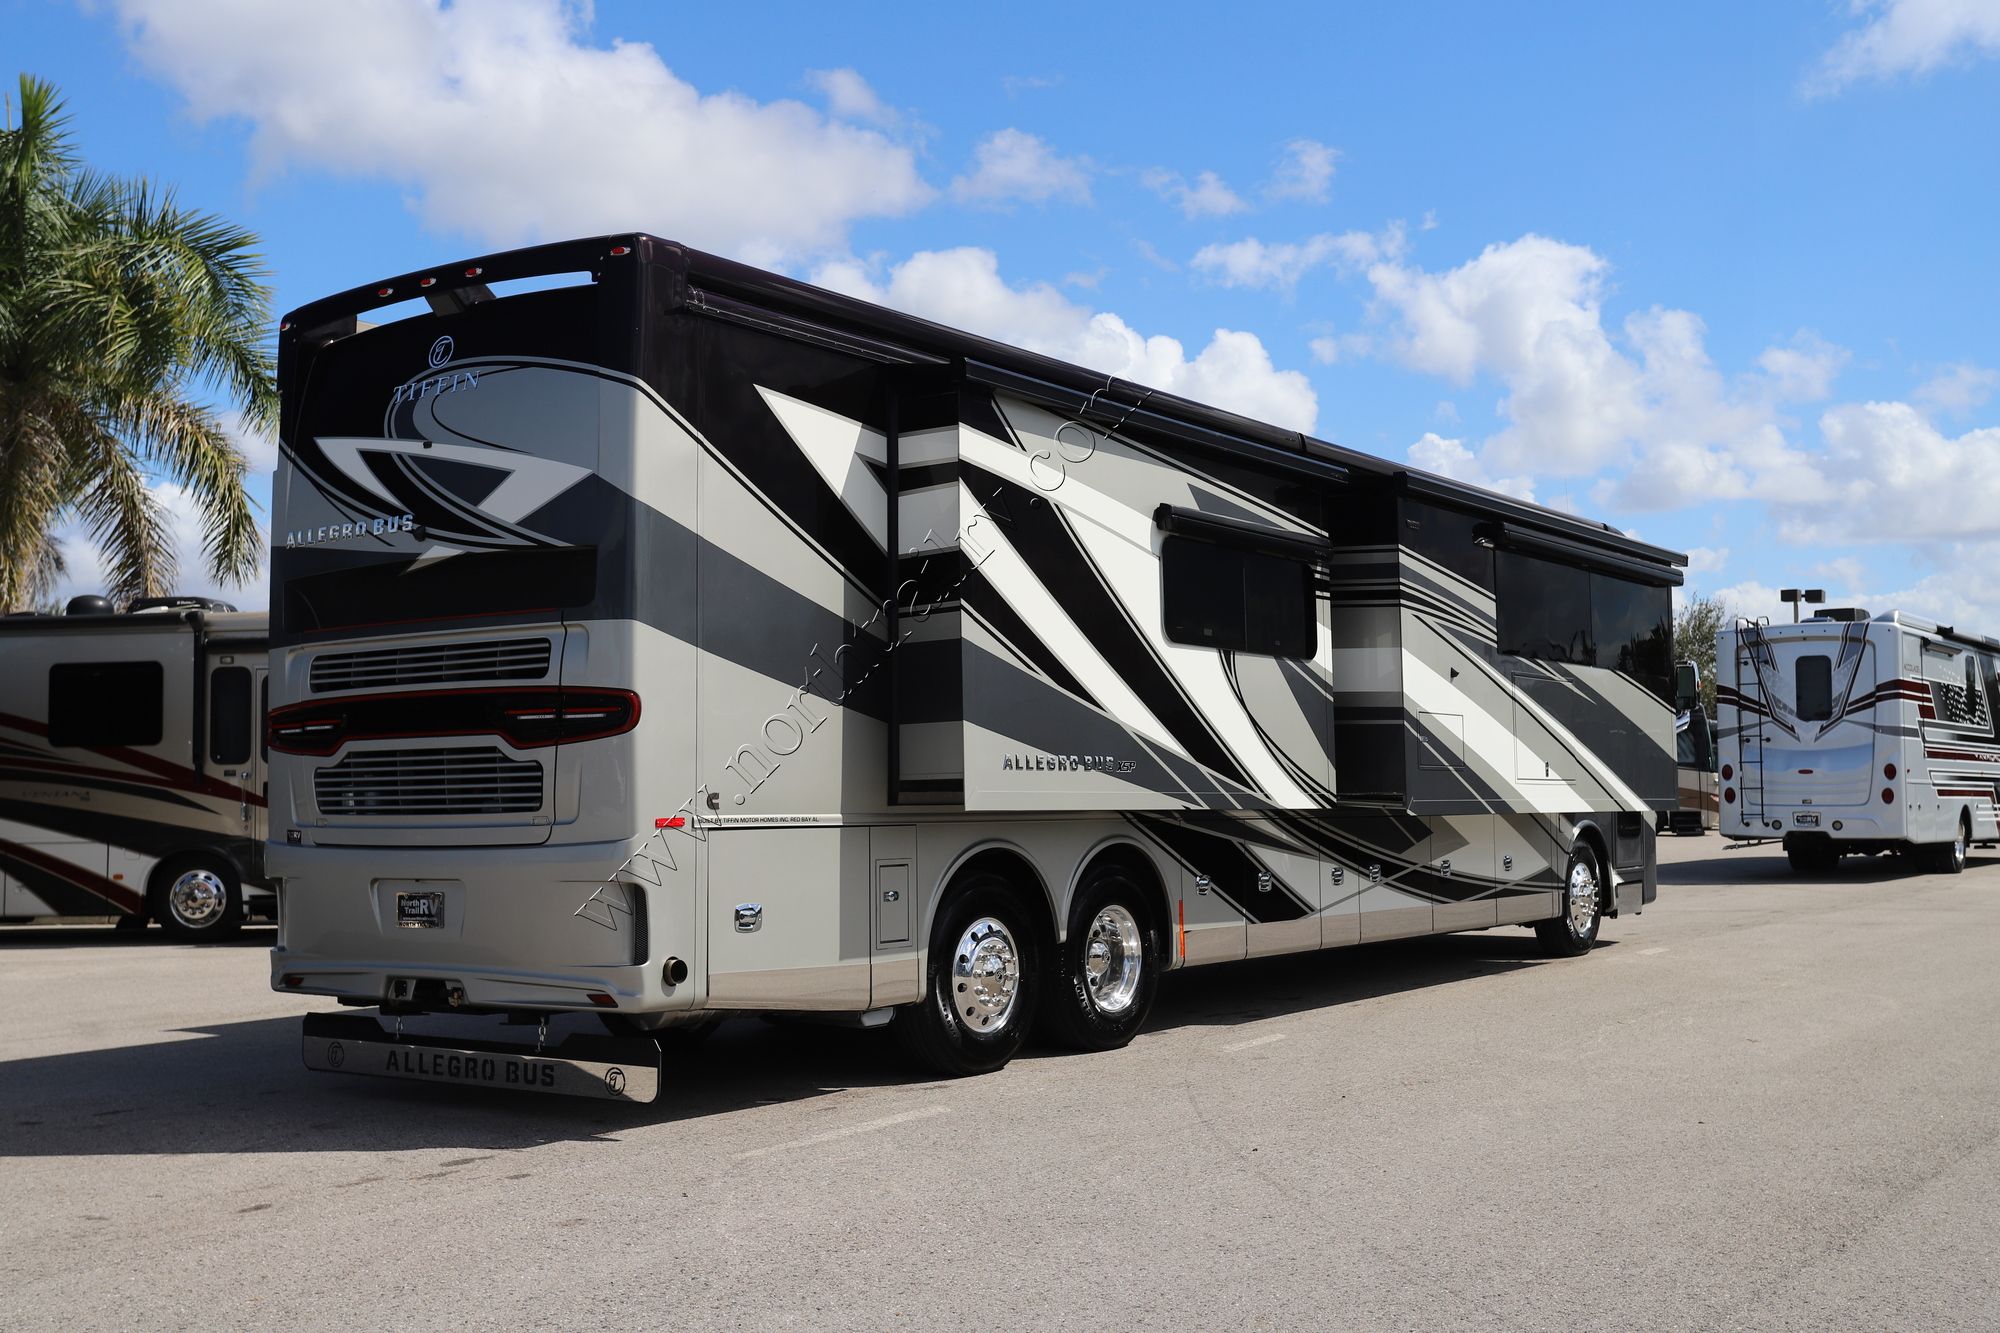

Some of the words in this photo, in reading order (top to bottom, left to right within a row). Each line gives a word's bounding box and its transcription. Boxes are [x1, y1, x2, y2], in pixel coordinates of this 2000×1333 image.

[393, 370, 480, 404] TIFFIN
[286, 522, 367, 549] ALLEGRO
[373, 514, 413, 536] BUS
[1003, 754, 1079, 771] ALLEGRO
[1083, 754, 1114, 772] BUS
[401, 899, 420, 907] North
[420, 899, 439, 915] RV
[404, 906, 420, 914] Trail
[386, 1050, 495, 1081] ALLEGRO
[505, 1061, 555, 1088] BUS
